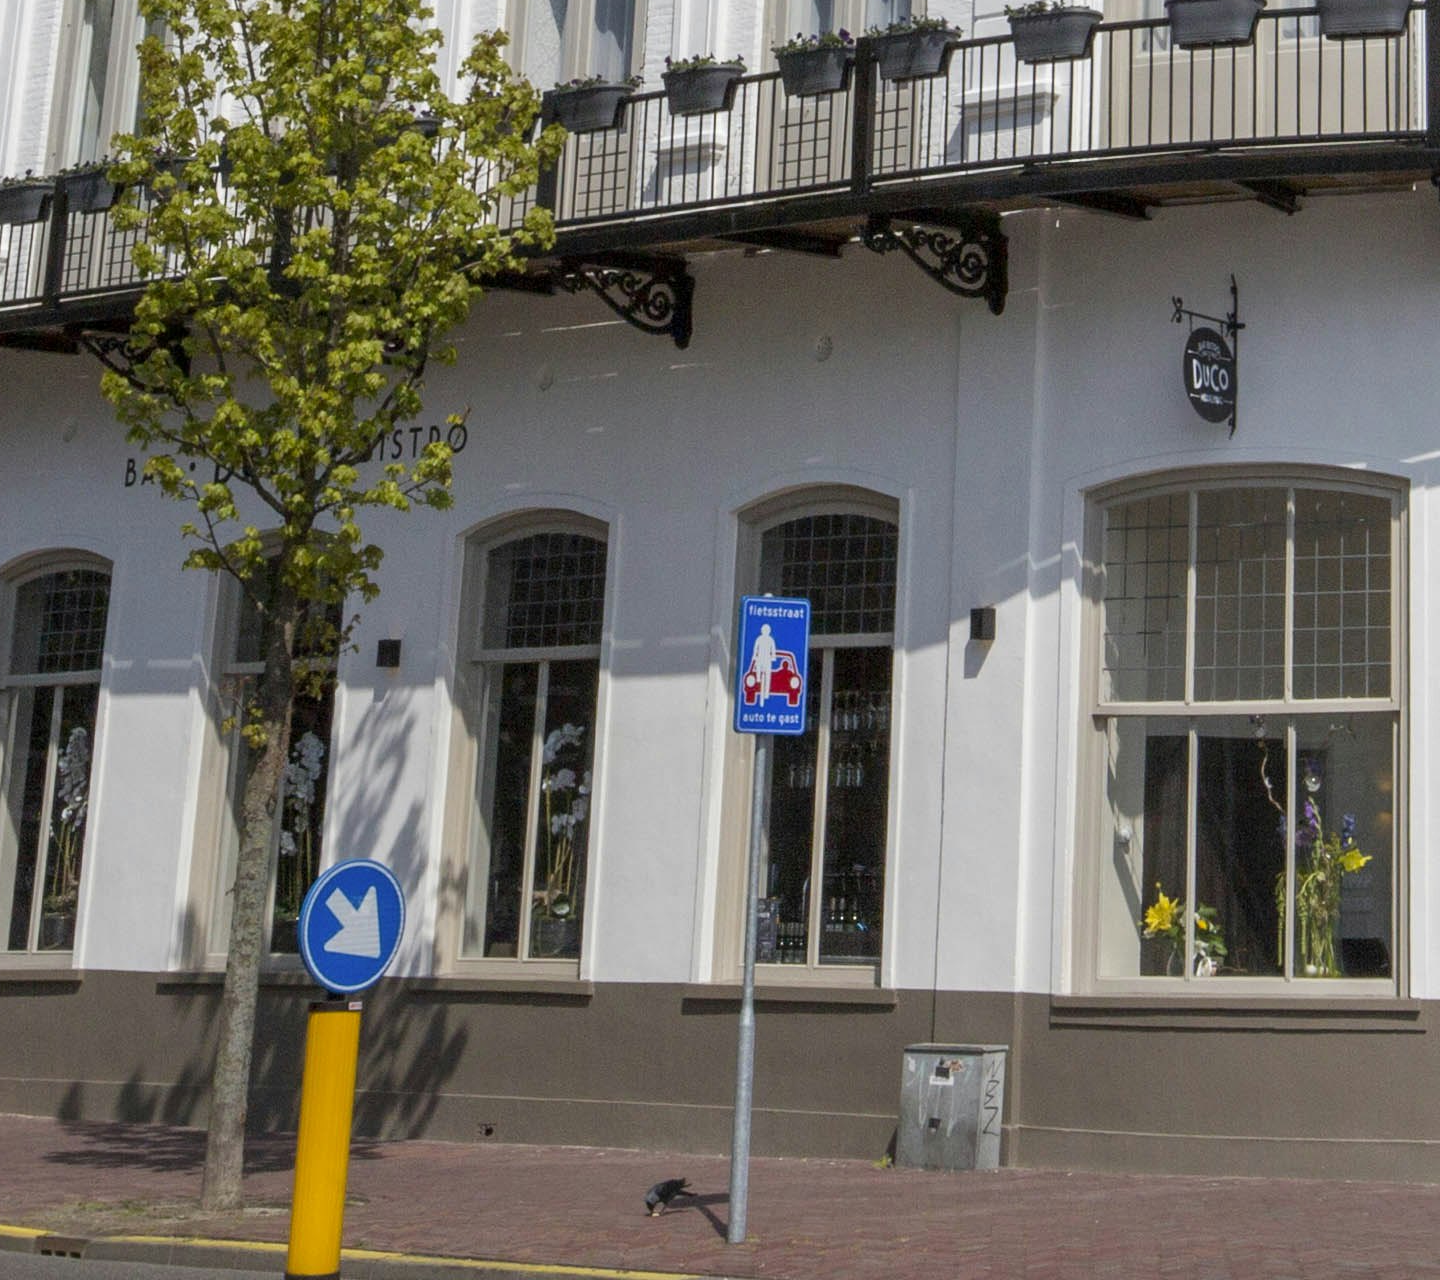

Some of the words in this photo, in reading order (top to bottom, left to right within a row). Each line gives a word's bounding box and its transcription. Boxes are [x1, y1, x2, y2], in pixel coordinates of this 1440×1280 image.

[748, 604, 805, 619] fietsstraat
[742, 711, 765, 724] auto
[766, 712, 777, 724] te
[778, 713, 800, 727] gast
